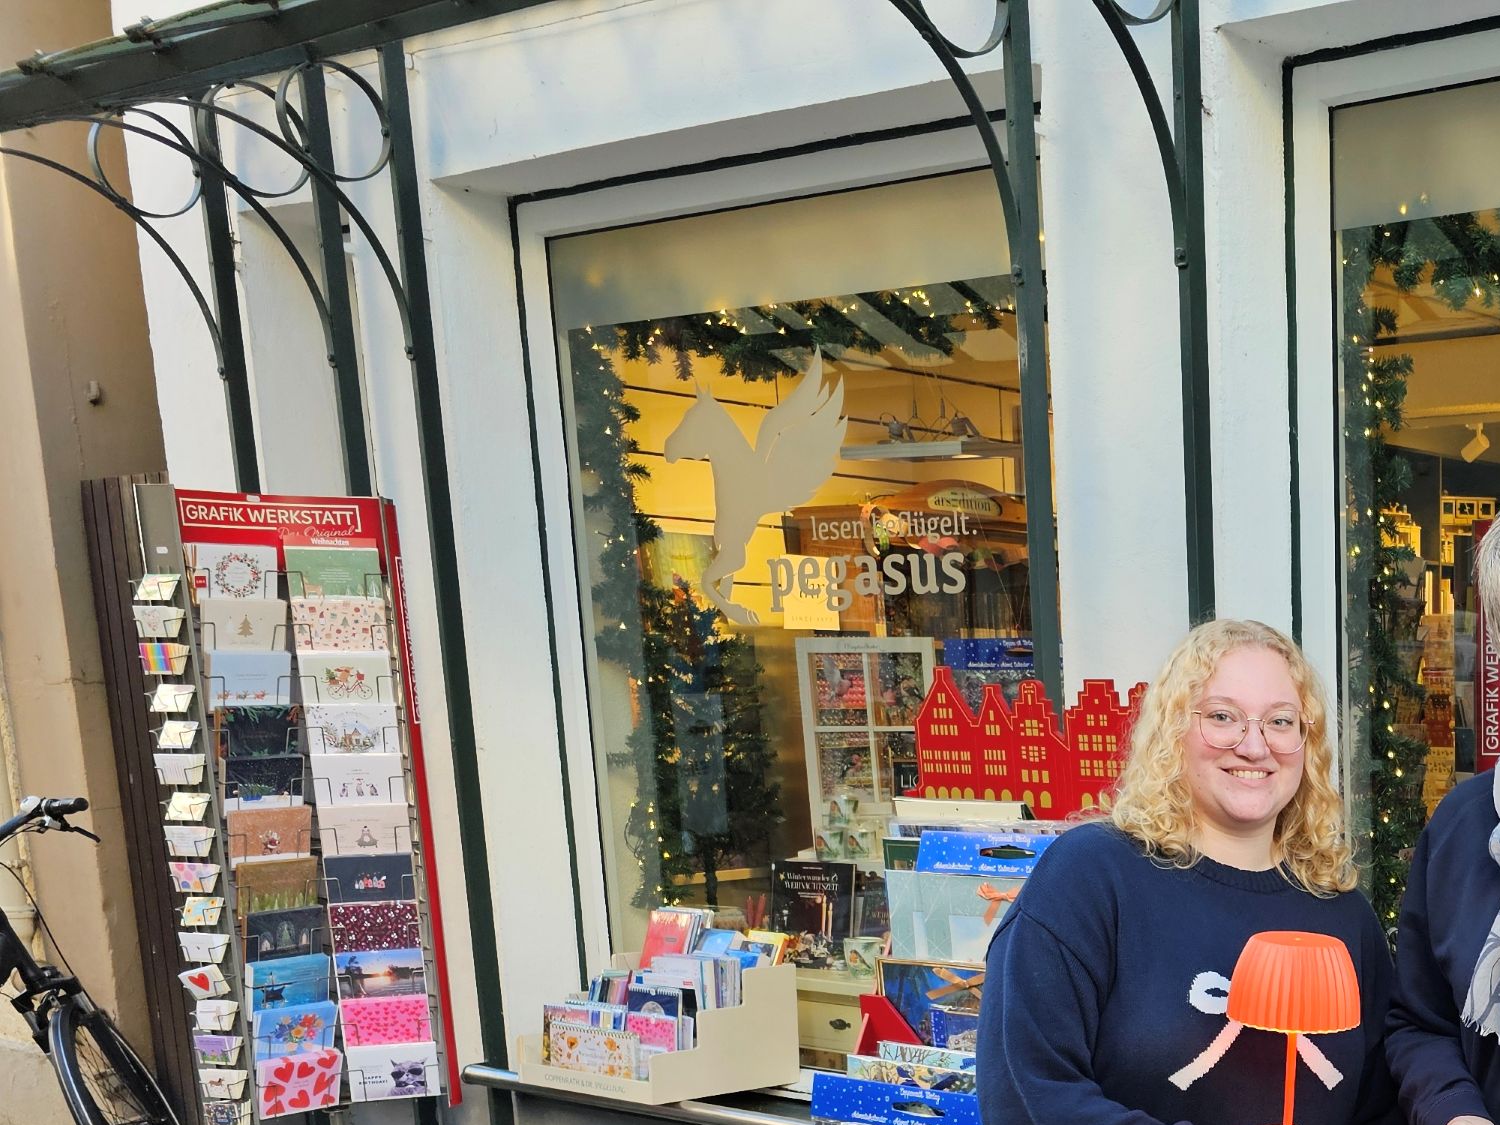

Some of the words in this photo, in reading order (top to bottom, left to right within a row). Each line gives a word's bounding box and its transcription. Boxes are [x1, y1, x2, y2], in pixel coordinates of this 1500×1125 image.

[246, 507, 354, 526] WERKSTATT
[810, 515, 864, 541] lesen
[872, 511, 978, 542] beflügelt.
[310, 538, 350, 546] Weihnachten
[767, 552, 966, 613] pegasus
[1486, 686, 1499, 750] GRAFiK
